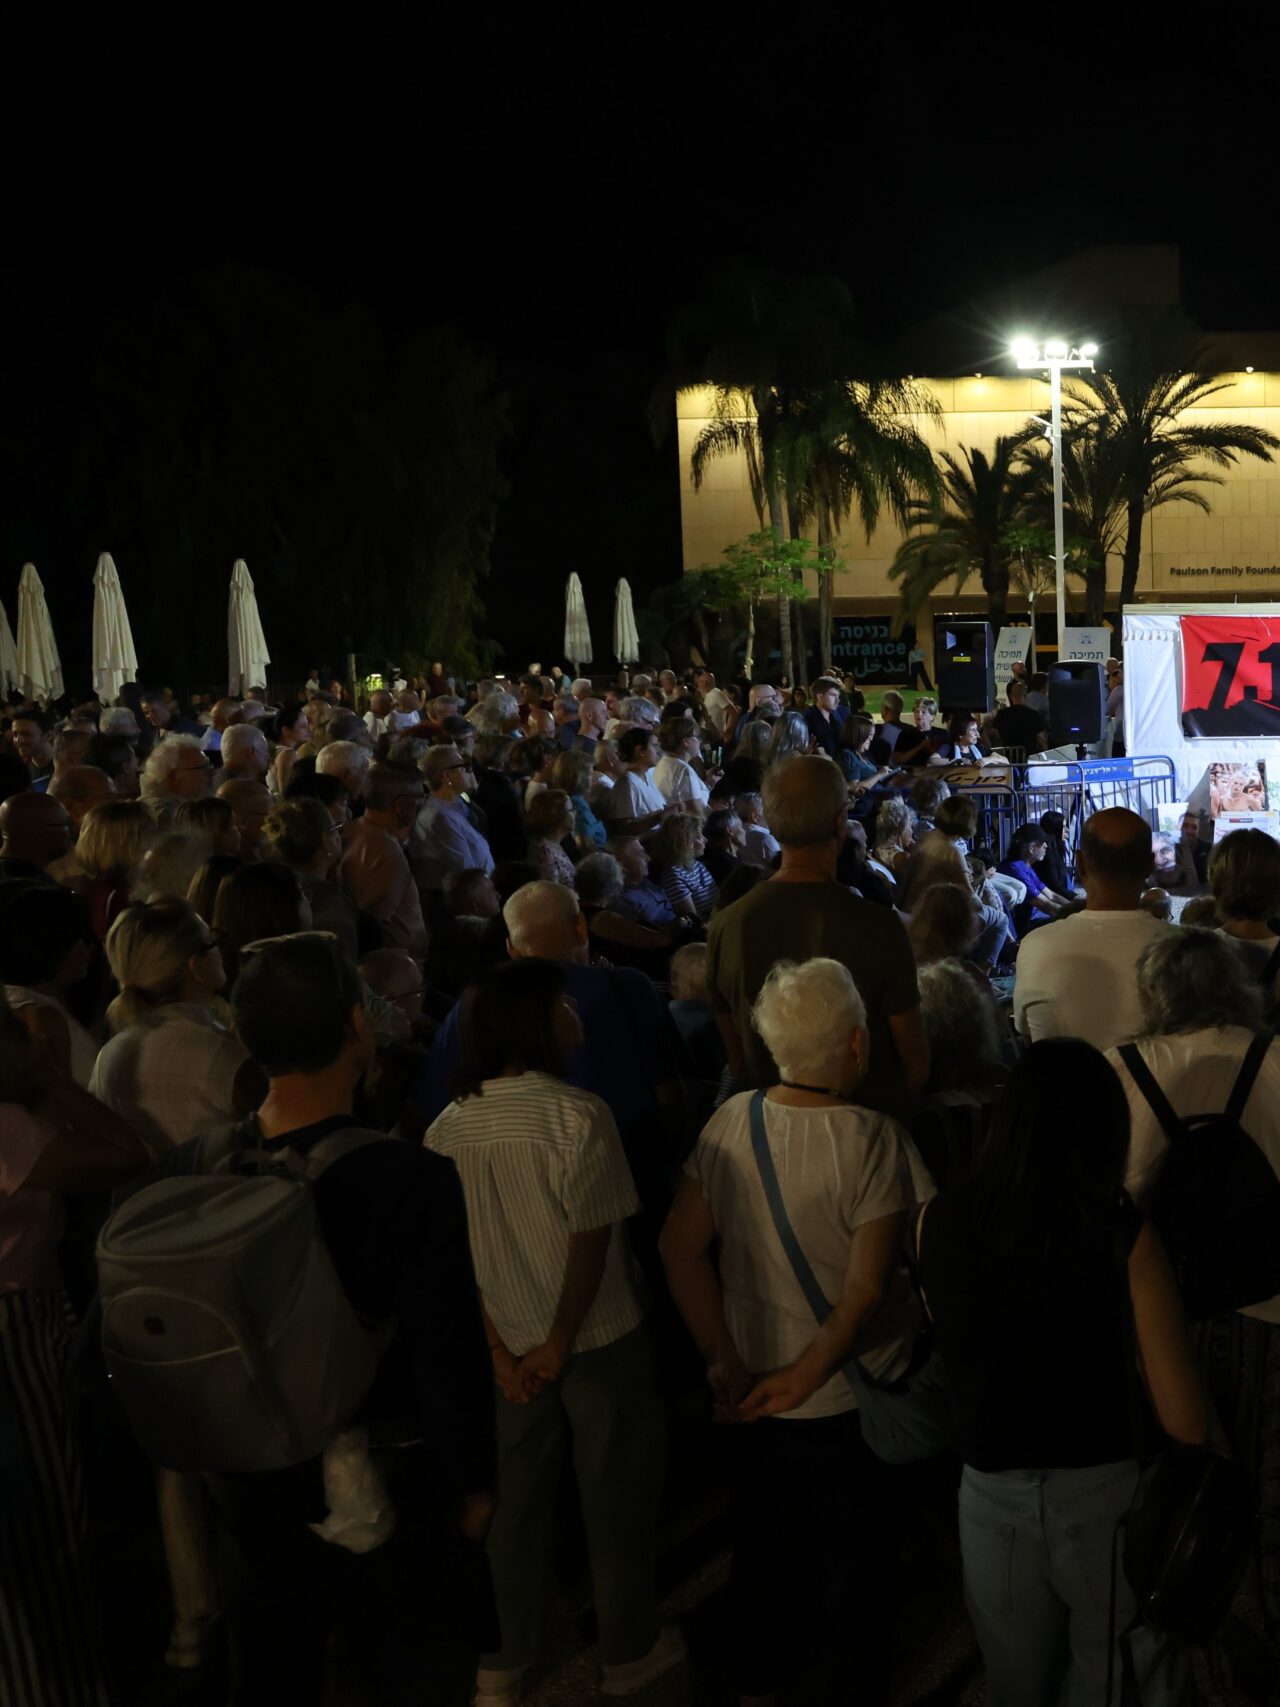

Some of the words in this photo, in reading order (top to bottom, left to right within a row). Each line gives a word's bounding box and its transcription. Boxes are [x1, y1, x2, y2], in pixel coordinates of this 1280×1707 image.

[1170, 566, 1209, 576] Paulson
[1210, 566, 1243, 577] Family
[839, 624, 889, 639] כניסה
[832, 641, 907, 656] ntrance
[998, 650, 1022, 658] תמיכה
[1069, 651, 1104, 660] תמיכה
[854, 657, 907, 678] مدخل
